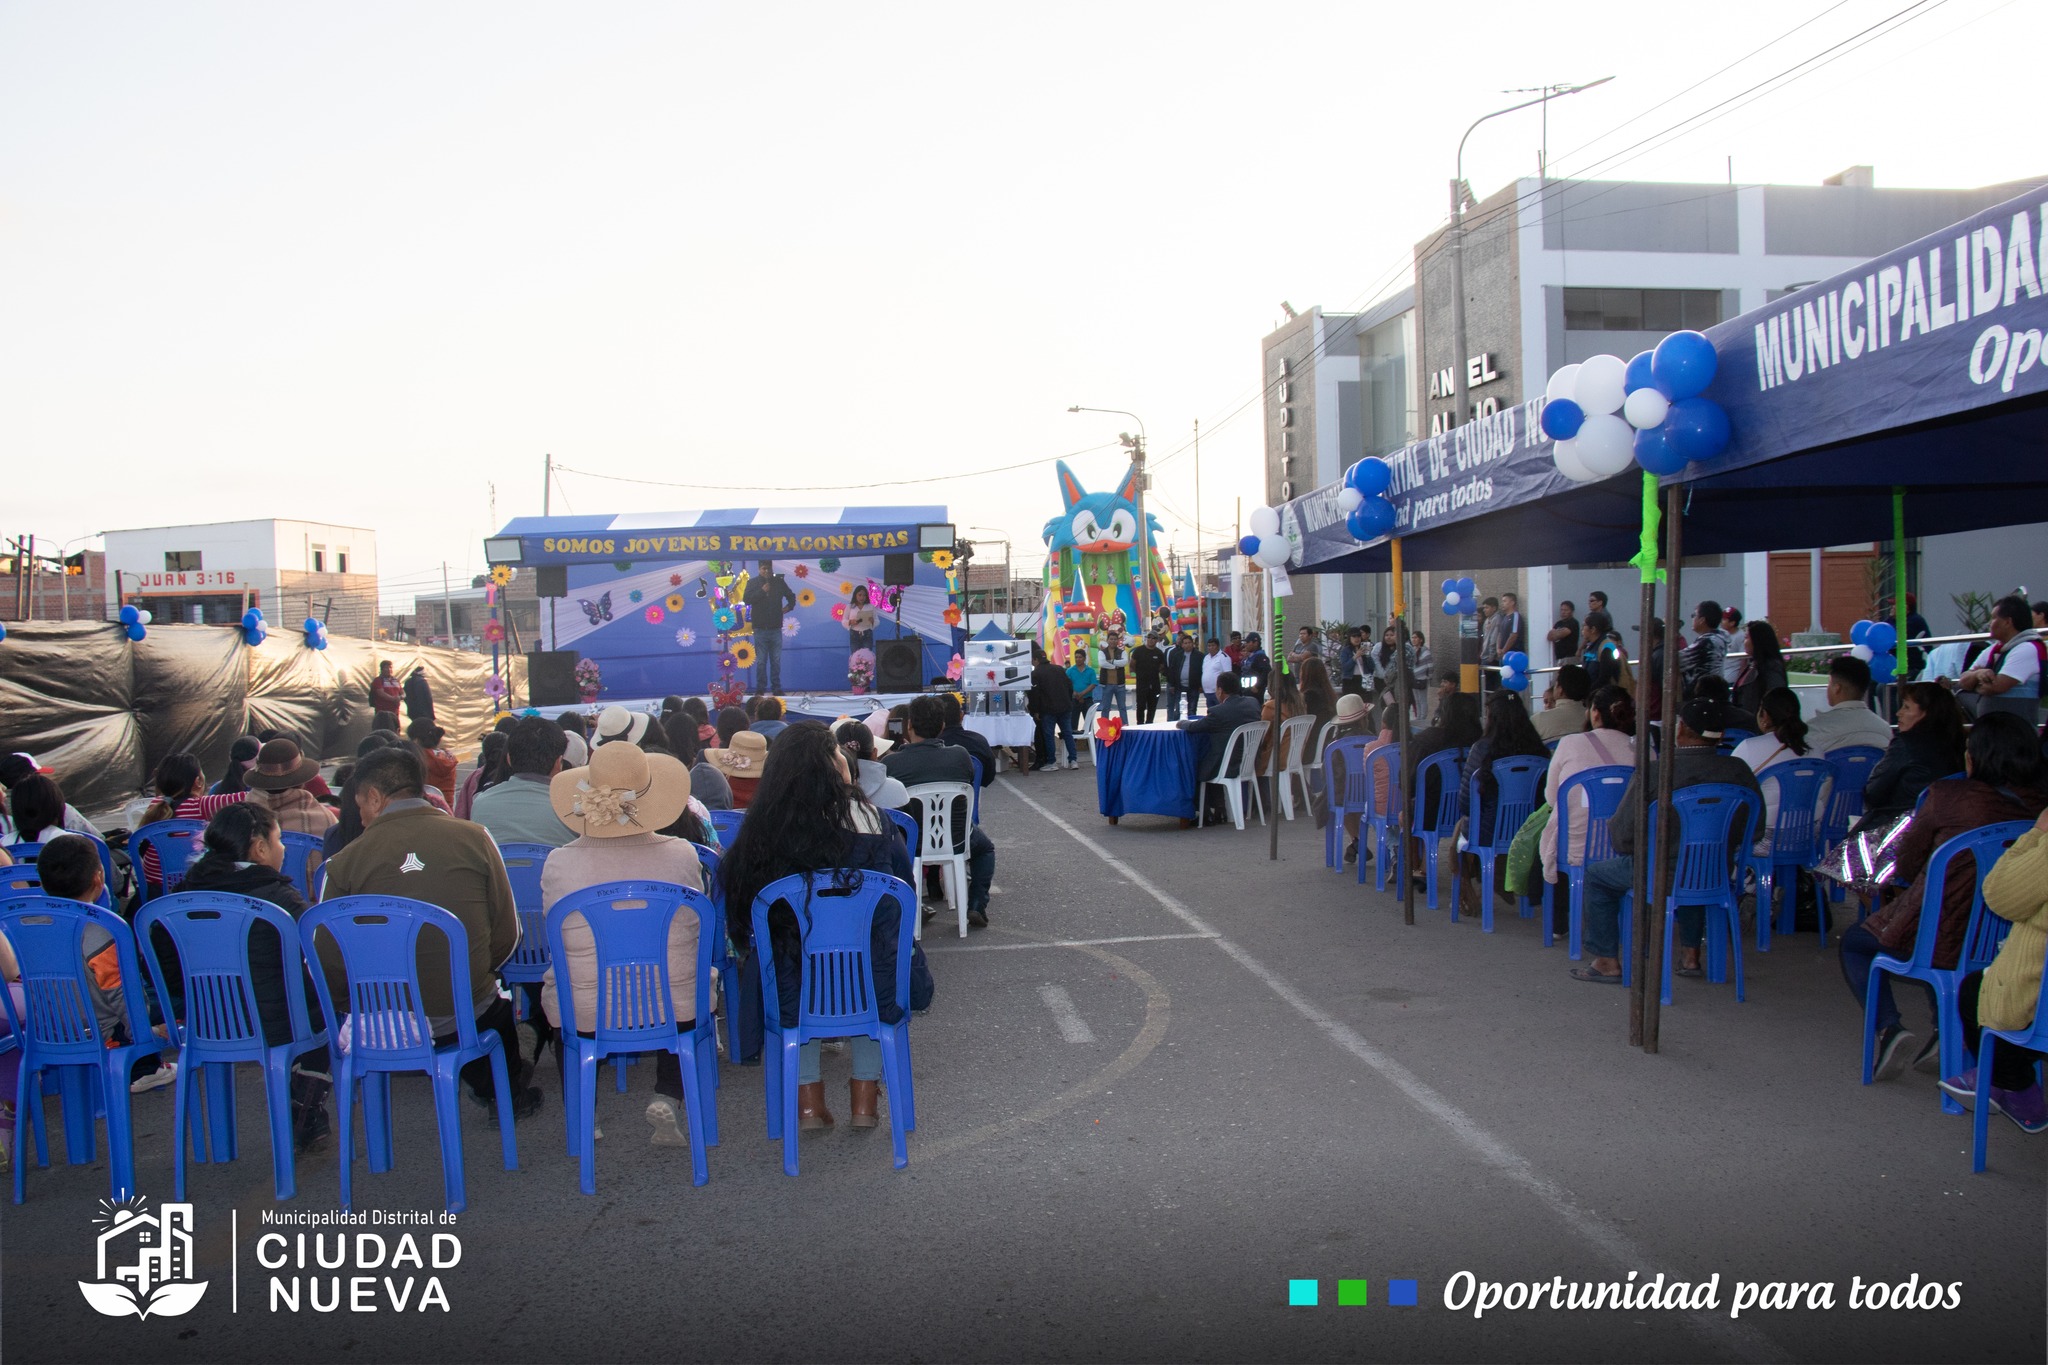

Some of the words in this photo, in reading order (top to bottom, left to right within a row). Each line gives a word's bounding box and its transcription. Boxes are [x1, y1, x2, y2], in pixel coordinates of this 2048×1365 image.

[1429, 352, 1498, 400] ANEL
[1429, 434, 1450, 481] DE
[1455, 408, 1515, 471] CIUDAD
[1413, 492, 1448, 528] para
[1451, 475, 1493, 510] todos
[544, 538, 615, 554] SOMOS
[623, 536, 721, 554] JOVENES
[729, 530, 909, 552] PROTAGONISTAS
[140, 573, 187, 587] JUAN
[196, 571, 235, 585] 3:16
